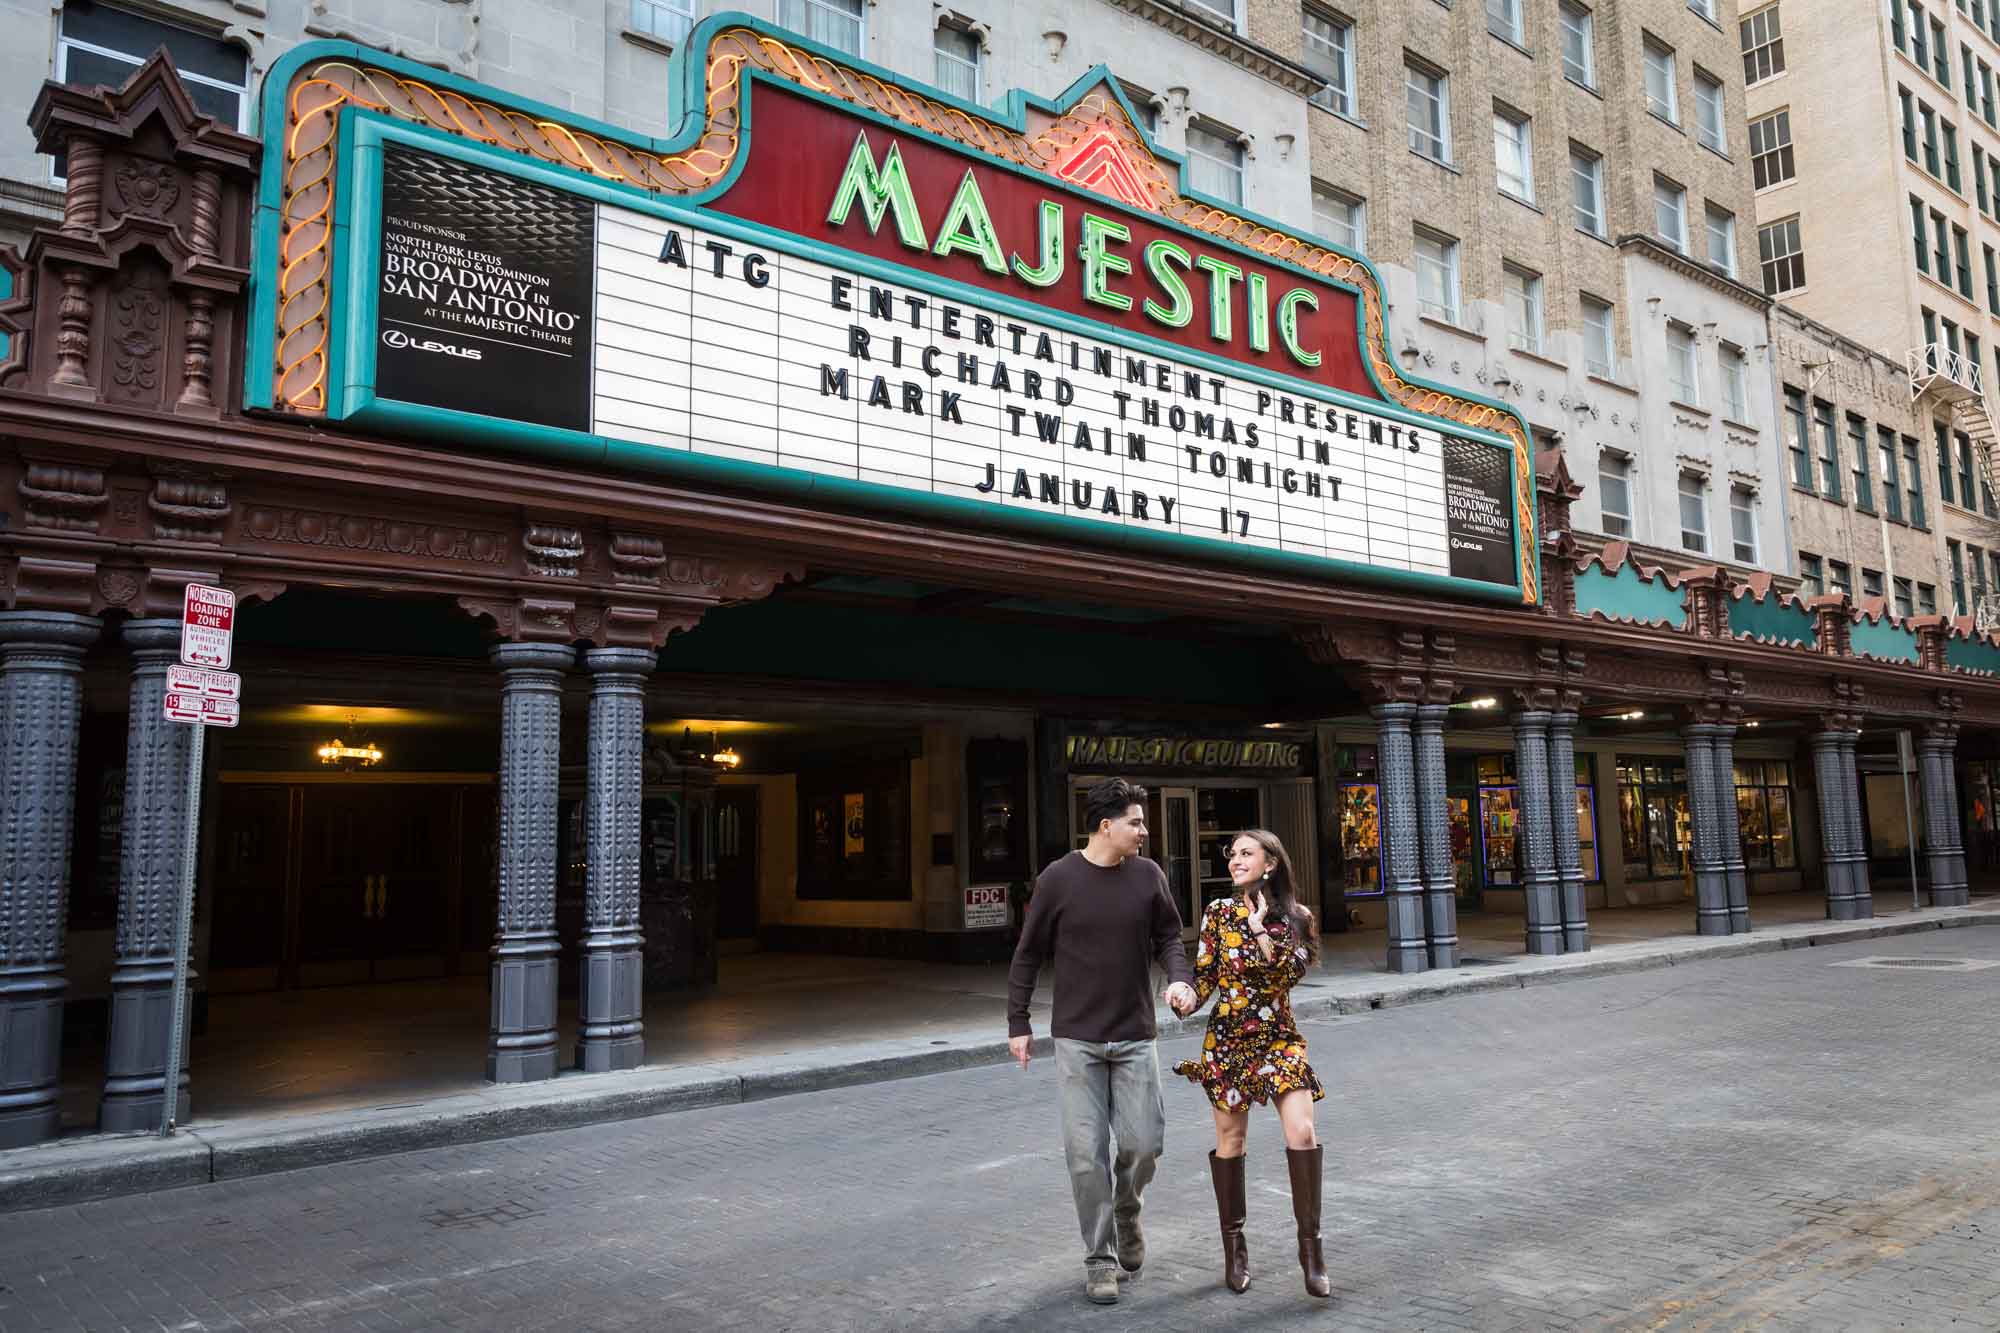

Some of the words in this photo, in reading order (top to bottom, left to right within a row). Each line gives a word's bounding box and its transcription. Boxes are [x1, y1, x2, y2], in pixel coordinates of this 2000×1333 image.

[387, 216, 421, 230] PROUD
[422, 224, 466, 241] SPONSOR
[386, 232, 431, 250] NORTH
[435, 243, 465, 258] PARK
[467, 250, 502, 267] LEXUS
[826, 128, 1322, 367] MAJESTIC
[385, 242, 409, 255] SAN
[412, 248, 471, 269] ANTONIO
[474, 262, 483, 272] &
[486, 264, 550, 287] DOMINION
[384, 274, 439, 303] SAN
[386, 253, 532, 301] BROADWAY
[534, 292, 549, 306] IN
[424, 307, 437, 318] AT
[438, 309, 462, 322] THE
[464, 314, 529, 336] MAJESTIC
[531, 328, 573, 346] THEATRE
[410, 338, 482, 360] LEXUS
[658, 229, 770, 288] ATG
[831, 274, 1225, 406] ENTERTAINMENT
[1257, 390, 1421, 453] PRESENTS
[848, 324, 1074, 407] RICHARD
[1113, 390, 1260, 448] THOMAS
[1297, 435, 1330, 466] IN
[820, 363, 963, 425] MARK
[1006, 405, 1146, 462] TWAIN
[1185, 444, 1342, 501] TONIGHT
[975, 463, 1176, 524] JANUARY
[1220, 507, 1250, 537] 17
[1448, 495, 1494, 513] BROADWAY
[1449, 506, 1466, 521] SAN
[1469, 512, 1508, 528] ANTONIO
[189, 586, 200, 601] NO
[190, 601, 229, 618] LOADING
[197, 614, 221, 627] ZONE
[208, 673, 237, 688] FREIGHT
[169, 696, 178, 707] 15
[204, 700, 214, 711] 30
[1072, 736, 1194, 766] MAJESTIC
[1201, 740, 1301, 768] BUILDING
[972, 888, 999, 904] FDC
